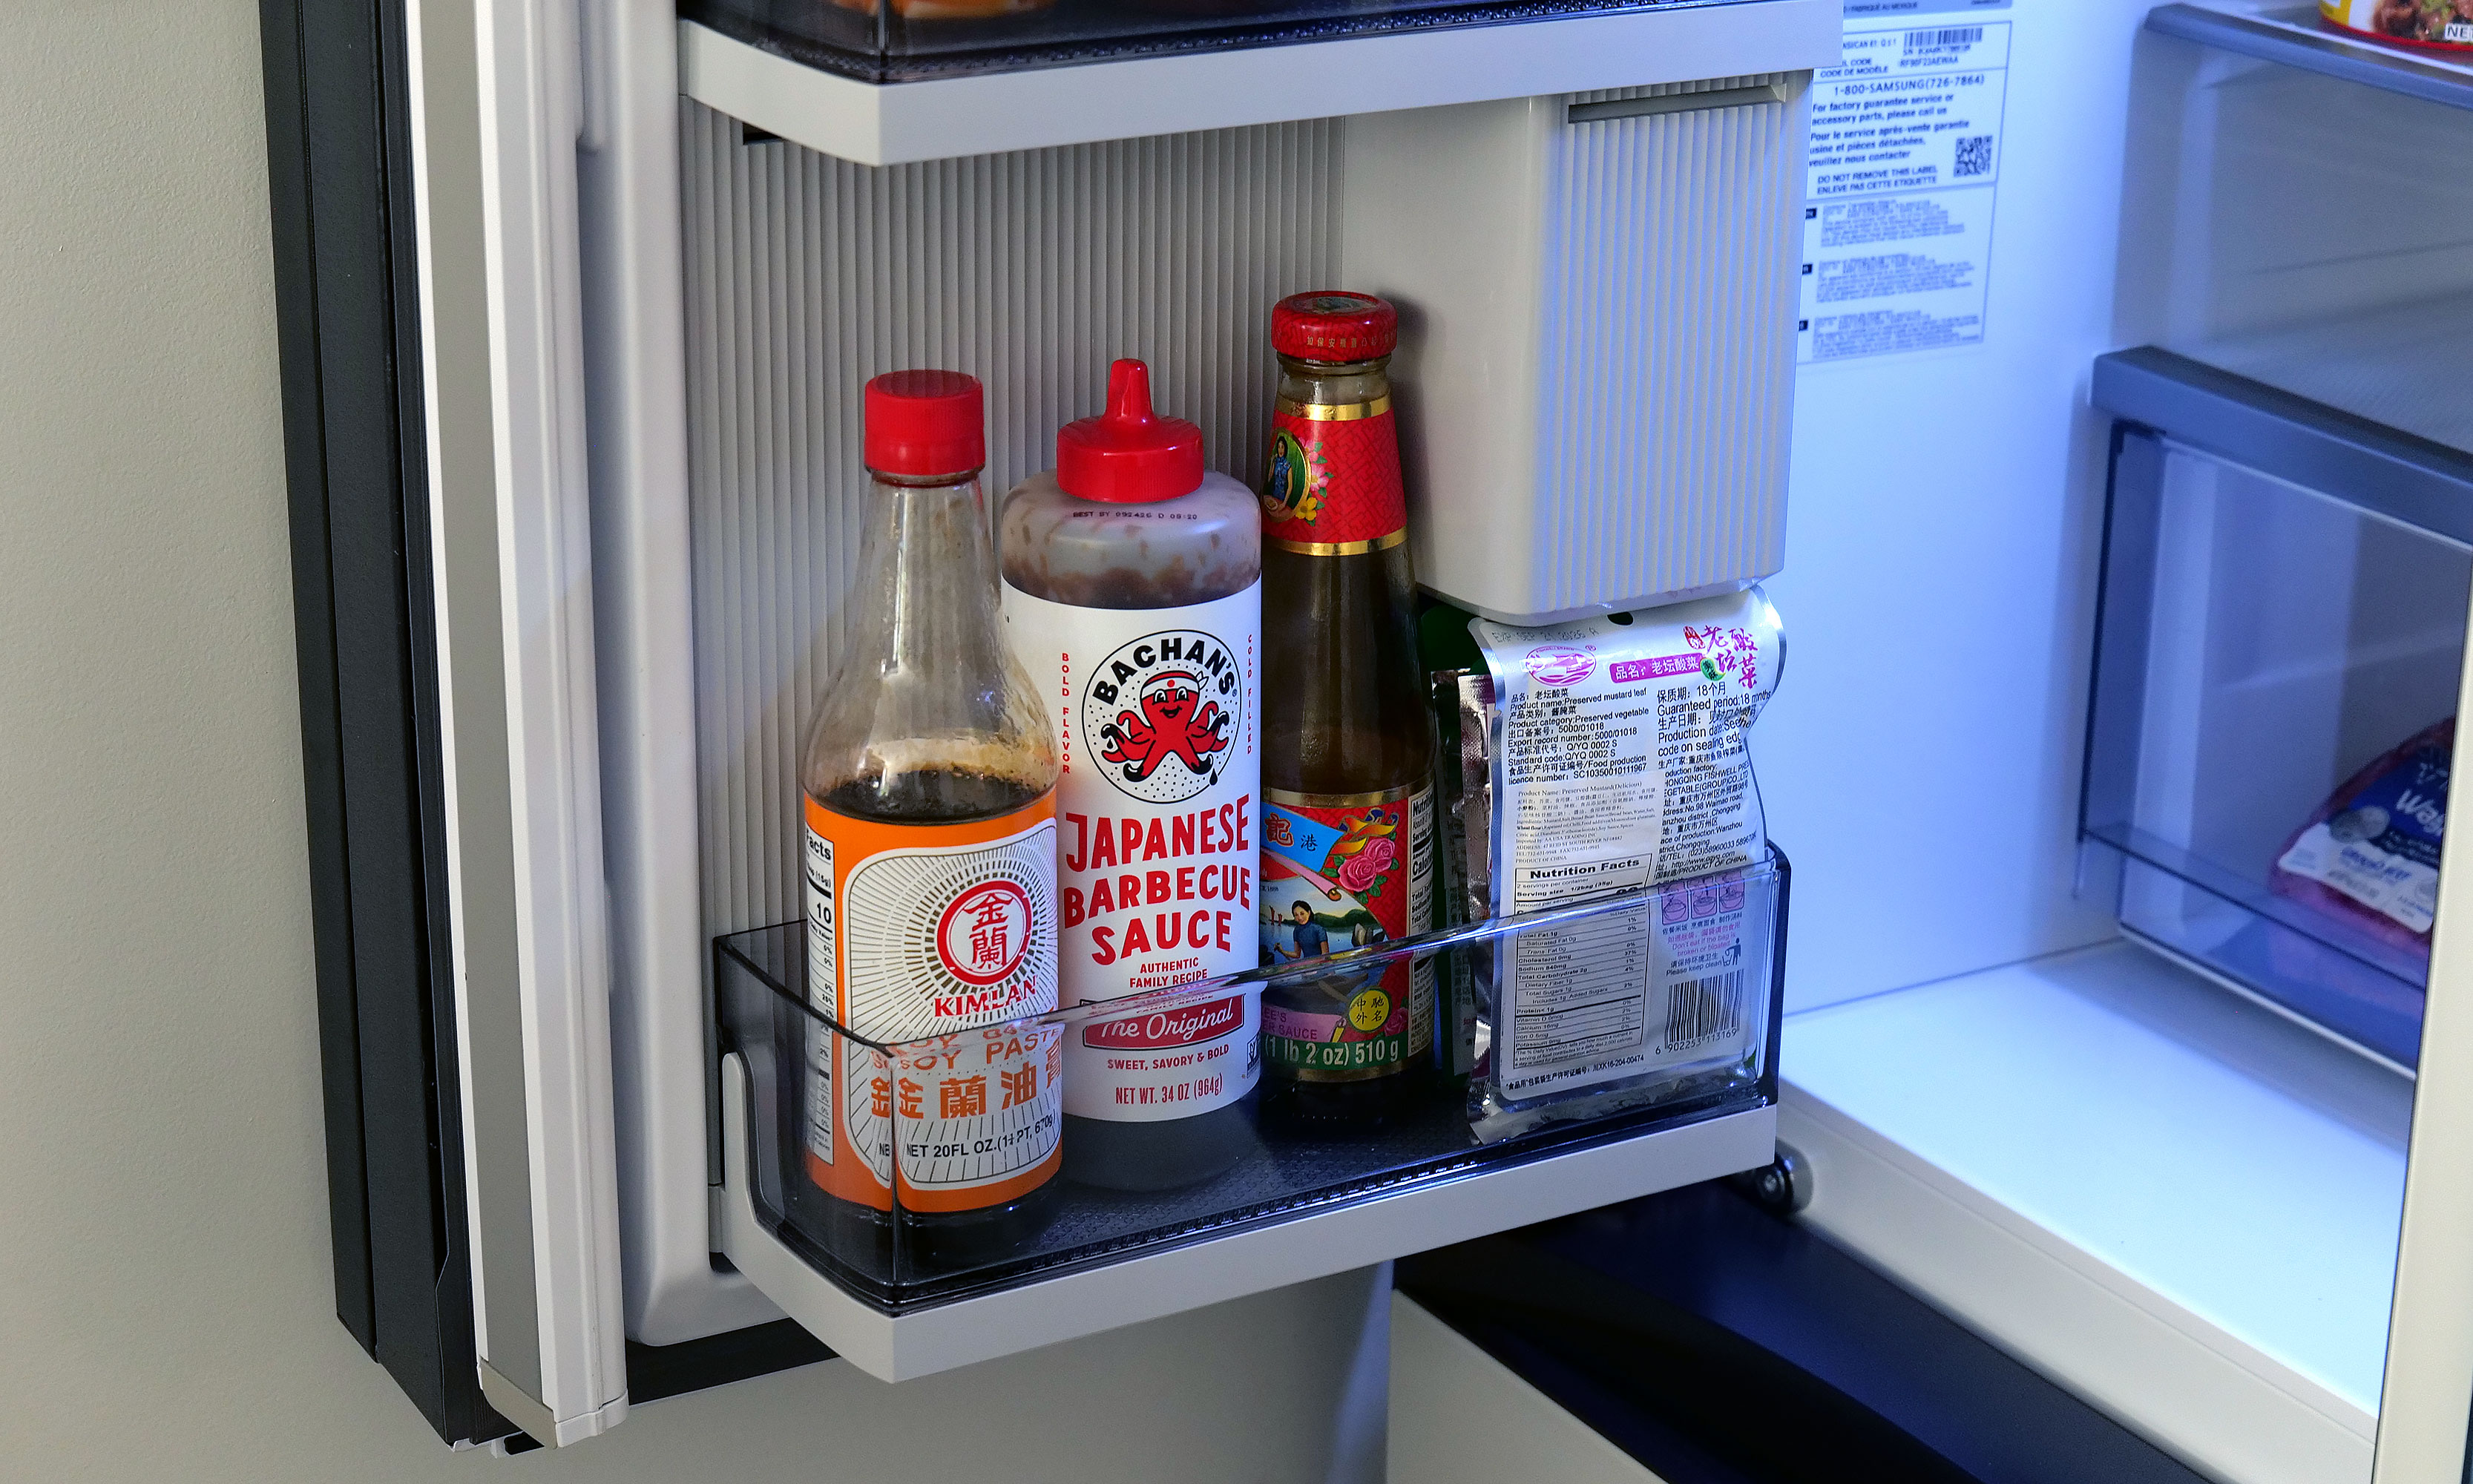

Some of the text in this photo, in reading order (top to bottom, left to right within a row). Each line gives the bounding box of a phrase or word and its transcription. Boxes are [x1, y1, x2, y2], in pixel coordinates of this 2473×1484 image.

[2447, 26, 2473, 38] NE
[1813, 104, 1826, 113] For
[1830, 101, 1860, 111] factory
[1863, 97, 1908, 110] guarantee
[1911, 95, 1942, 104] service
[1811, 115, 1856, 126] accessory
[1887, 110, 1916, 120] please
[1919, 107, 1934, 116] call
[1810, 132, 1830, 141] Pour
[1833, 131, 1841, 139] le
[1844, 128, 1876, 138] service
[1810, 145, 1833, 154] usine
[1845, 154, 1866, 162] nous
[1868, 151, 1911, 161] contacter
[1818, 175, 1830, 184] DO
[1833, 173, 1850, 182] NOT
[1853, 170, 1888, 180] REMOVE
[1092, 637, 1236, 705] BACHAN'S
[1535, 688, 1569, 700] 老坛酸菜
[1697, 681, 1726, 697] 18个月
[1510, 687, 1646, 711] Product mustard leaf
[1658, 698, 1711, 716] Guaranteed
[1062, 653, 1071, 774] BOLD FLAVOR
[1508, 720, 1537, 729] Product
[1615, 706, 1649, 719] vegetable
[1558, 722, 1604, 734] 5000/01018
[1658, 726, 1706, 743] Production
[1508, 735, 1558, 749] Export record
[1567, 742, 1588, 751] Q/YQ
[1591, 741, 1610, 749] 0002
[1612, 739, 1618, 747] S
[1658, 745, 1678, 757] code
[1681, 742, 1692, 752] on
[1696, 737, 1724, 751] sealing
[1508, 755, 1543, 766] Standard
[1589, 749, 1608, 758] 0002
[1611, 749, 1616, 757] S
[1609, 755, 1646, 769] production
[1508, 775, 1534, 785] licence
[1704, 766, 1737, 780] FISHWELL
[1518, 790, 1540, 798] Product
[1065, 793, 1249, 873] JAPANESE
[1264, 812, 1295, 847] 記
[1300, 834, 1318, 853] 港
[1725, 855, 1747, 864] CHINA
[1530, 859, 1640, 879] Nutrition Facts
[1064, 864, 1250, 930] BARBECUE
[816, 902, 832, 925] 10
[963, 890, 1016, 971] 金蘭
[1091, 910, 1232, 966] SAUCE
[1140, 957, 1199, 974] AUTHENTIC
[1130, 968, 1208, 988] FAMILY RECIPE
[933, 974, 1038, 1019] KIMLAN
[1100, 998, 1233, 1042] The Original
[1263, 1008, 1287, 1023] EE'S
[1278, 1023, 1318, 1040] SAUCE
[986, 1028, 1060, 1065] PASTE
[1306, 1042, 1317, 1065] 2
[1322, 1042, 1350, 1067] oz)
[1355, 1040, 1385, 1065] 510
[1390, 1039, 1399, 1062] g
[1655, 1045, 1661, 1054] 6
[1668, 1038, 1701, 1053] 902253
[1107, 1044, 1229, 1071] SWEET, SAVORY & BOLD
[1115, 1072, 1224, 1105] NET WT. 34 OZ (964g)
[907, 1144, 928, 1158] NET
[933, 1144, 969, 1158] 20FL
